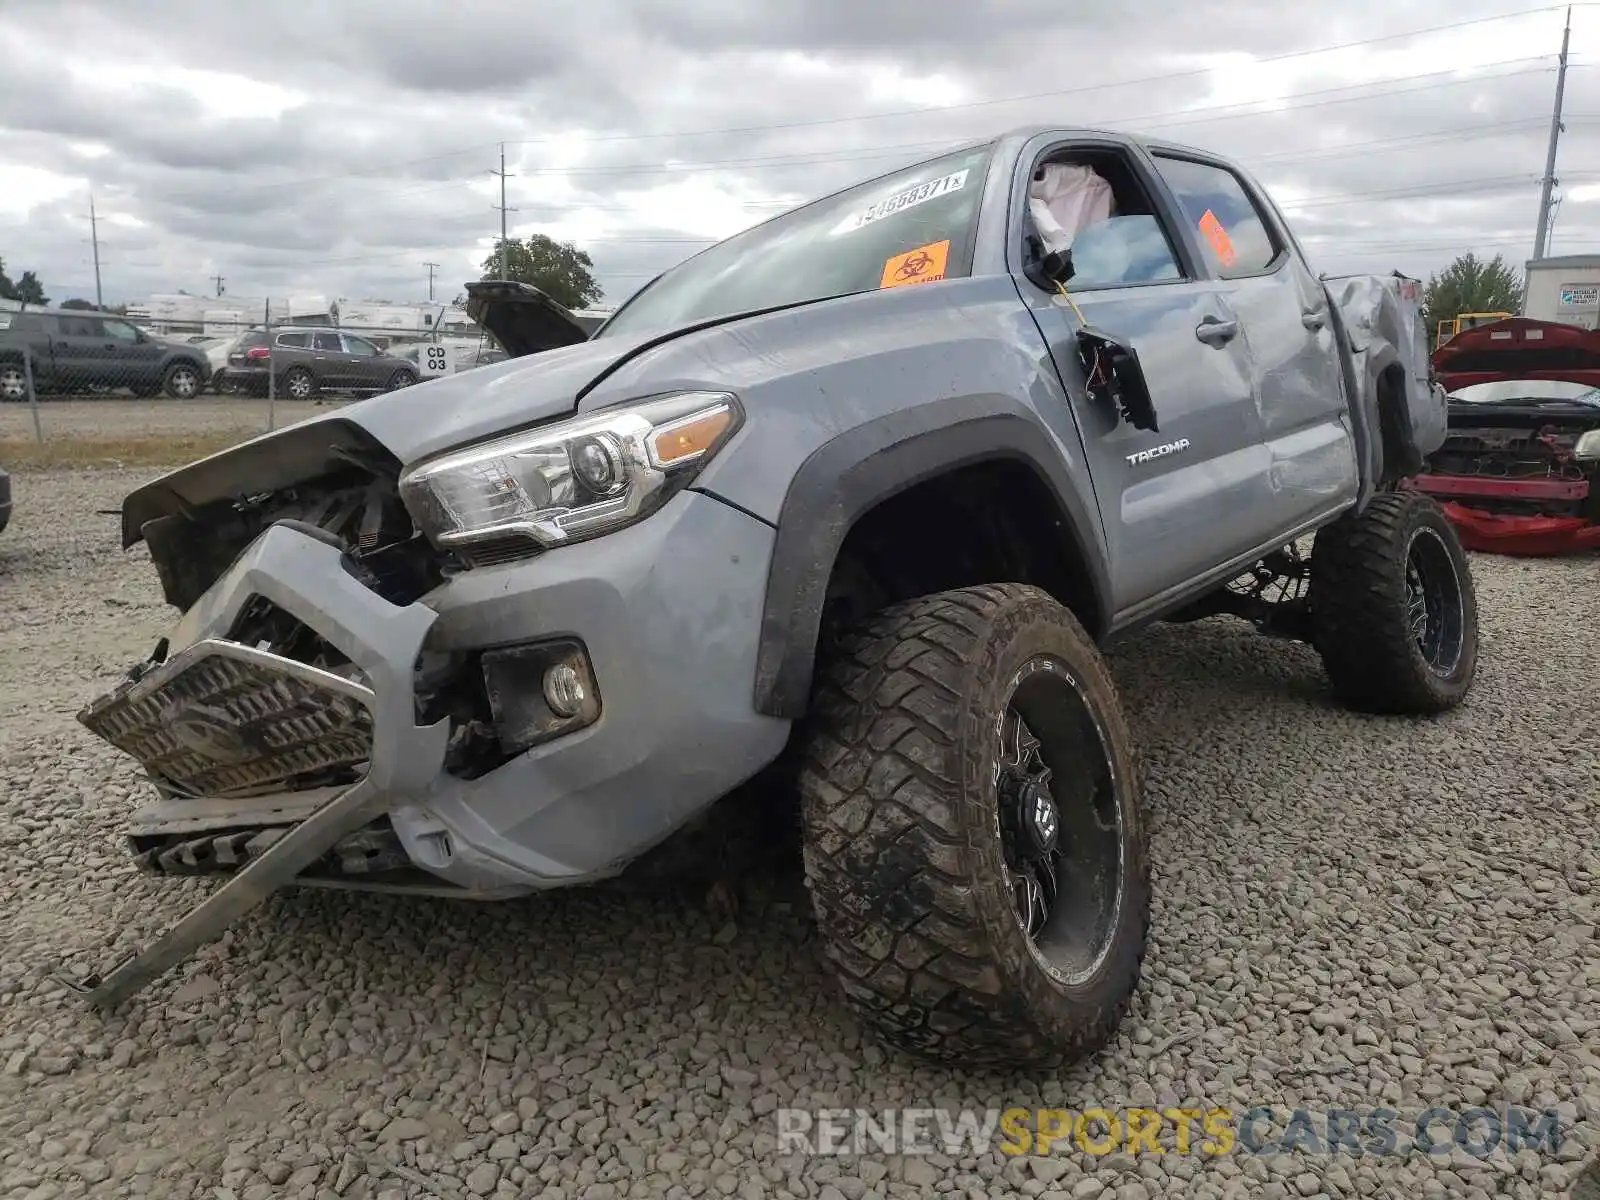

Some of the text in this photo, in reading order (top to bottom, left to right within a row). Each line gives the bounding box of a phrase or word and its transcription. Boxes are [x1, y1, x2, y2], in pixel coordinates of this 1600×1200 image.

[427, 347, 446, 358] CD
[428, 359, 446, 370] 03
[1125, 438, 1190, 465] TACOMA
